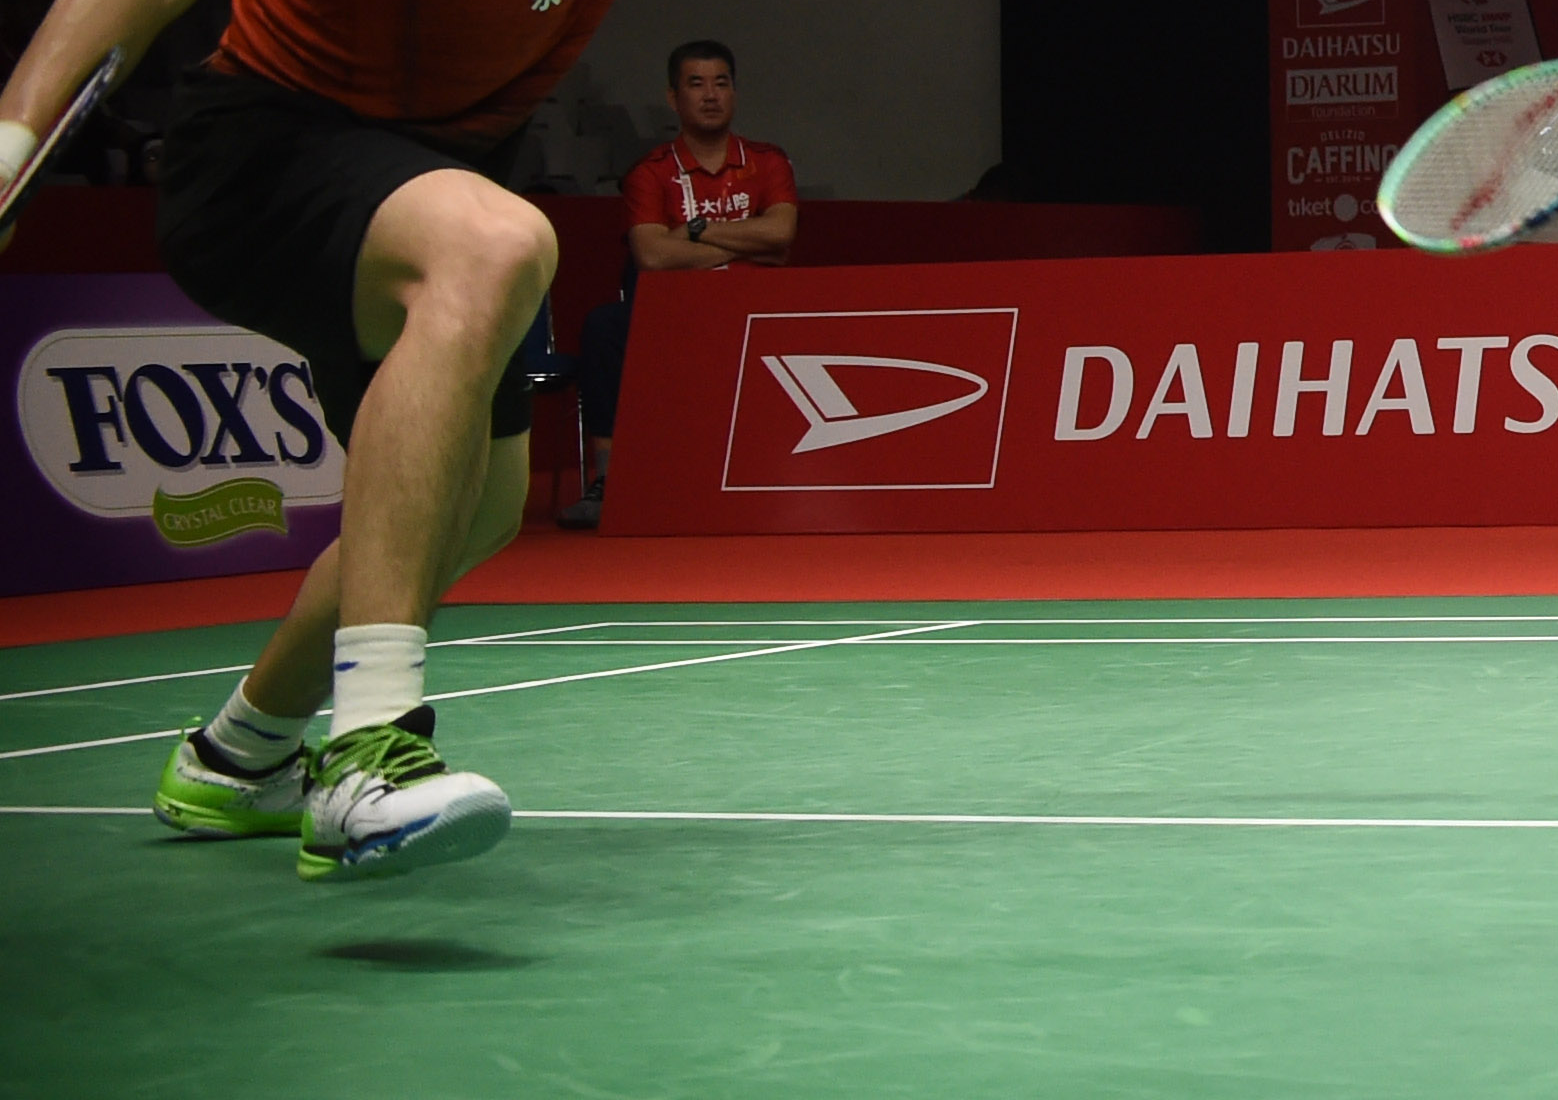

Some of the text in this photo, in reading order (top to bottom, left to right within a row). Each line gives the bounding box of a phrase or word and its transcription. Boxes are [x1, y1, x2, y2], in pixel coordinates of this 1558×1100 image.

[1282, 33, 1400, 60] DAIHATSU
[1290, 71, 1395, 100] DJARUM
[46, 361, 324, 473] FOX'S
[163, 496, 277, 531] CRYSTAL CLEAR
